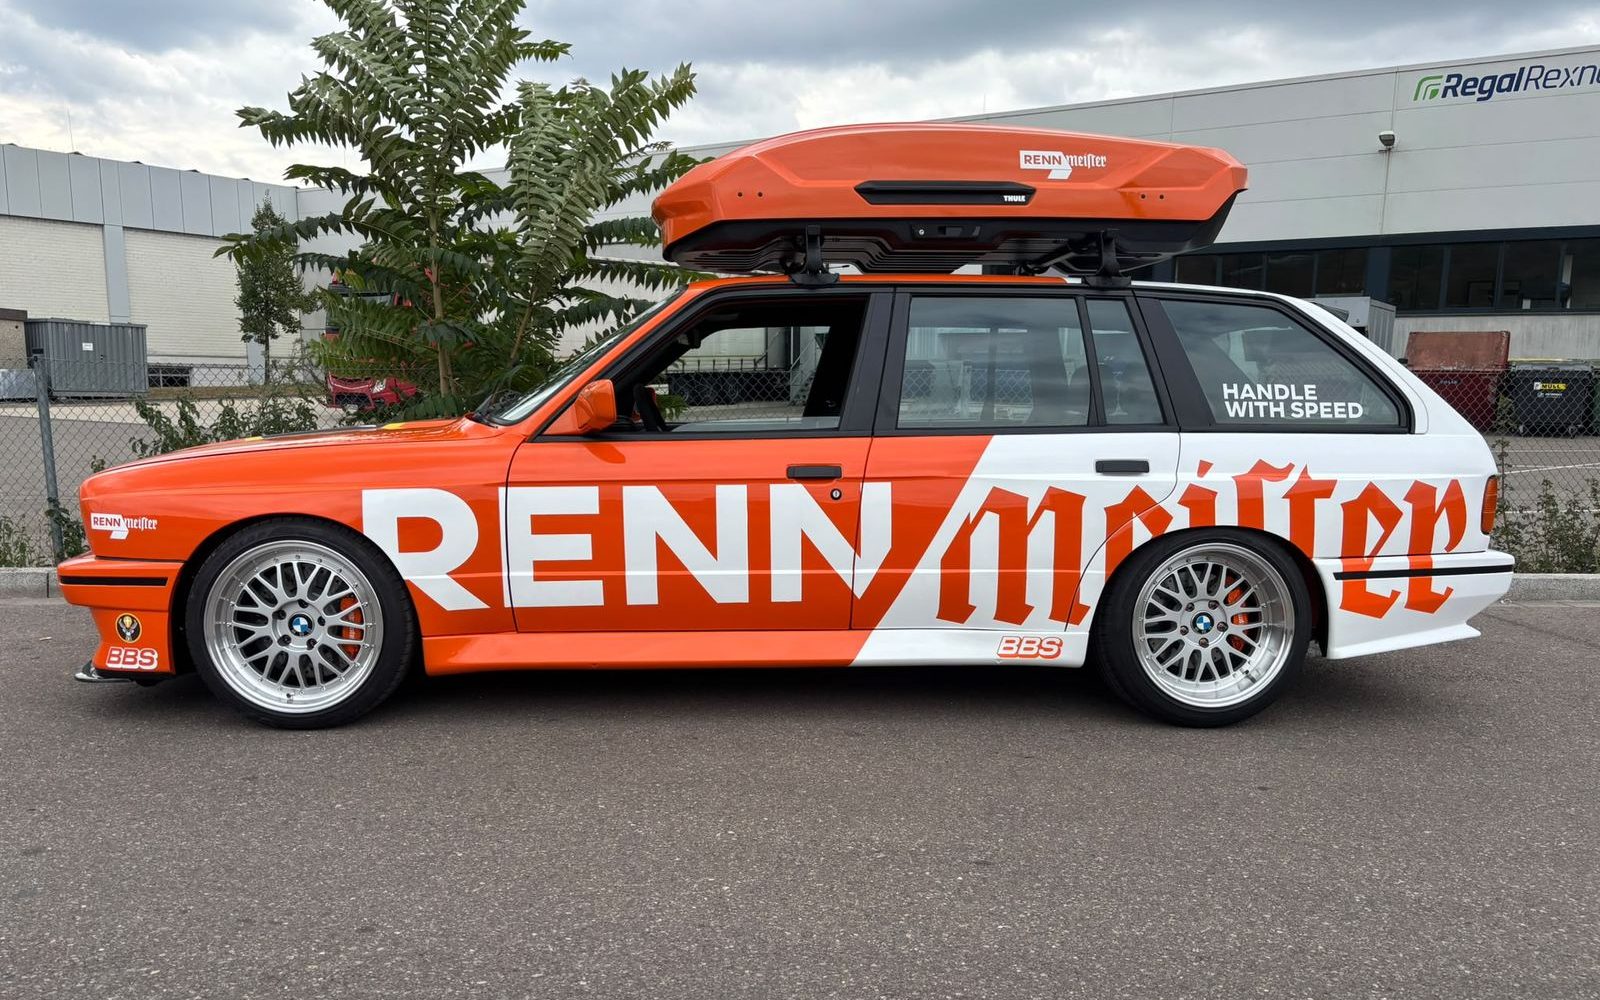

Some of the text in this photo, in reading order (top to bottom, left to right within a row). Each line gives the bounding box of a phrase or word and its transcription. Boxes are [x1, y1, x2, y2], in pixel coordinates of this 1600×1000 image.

[1024, 154, 1062, 166] RENN
[1003, 195, 1026, 203] THULE
[1222, 383, 1318, 400] HANDLE
[1224, 401, 1364, 419] WITH SPEED
[93, 516, 121, 527] RENN
[361, 481, 893, 612] RENN
[996, 635, 1064, 659] BBS
[105, 646, 159, 670] BBS
